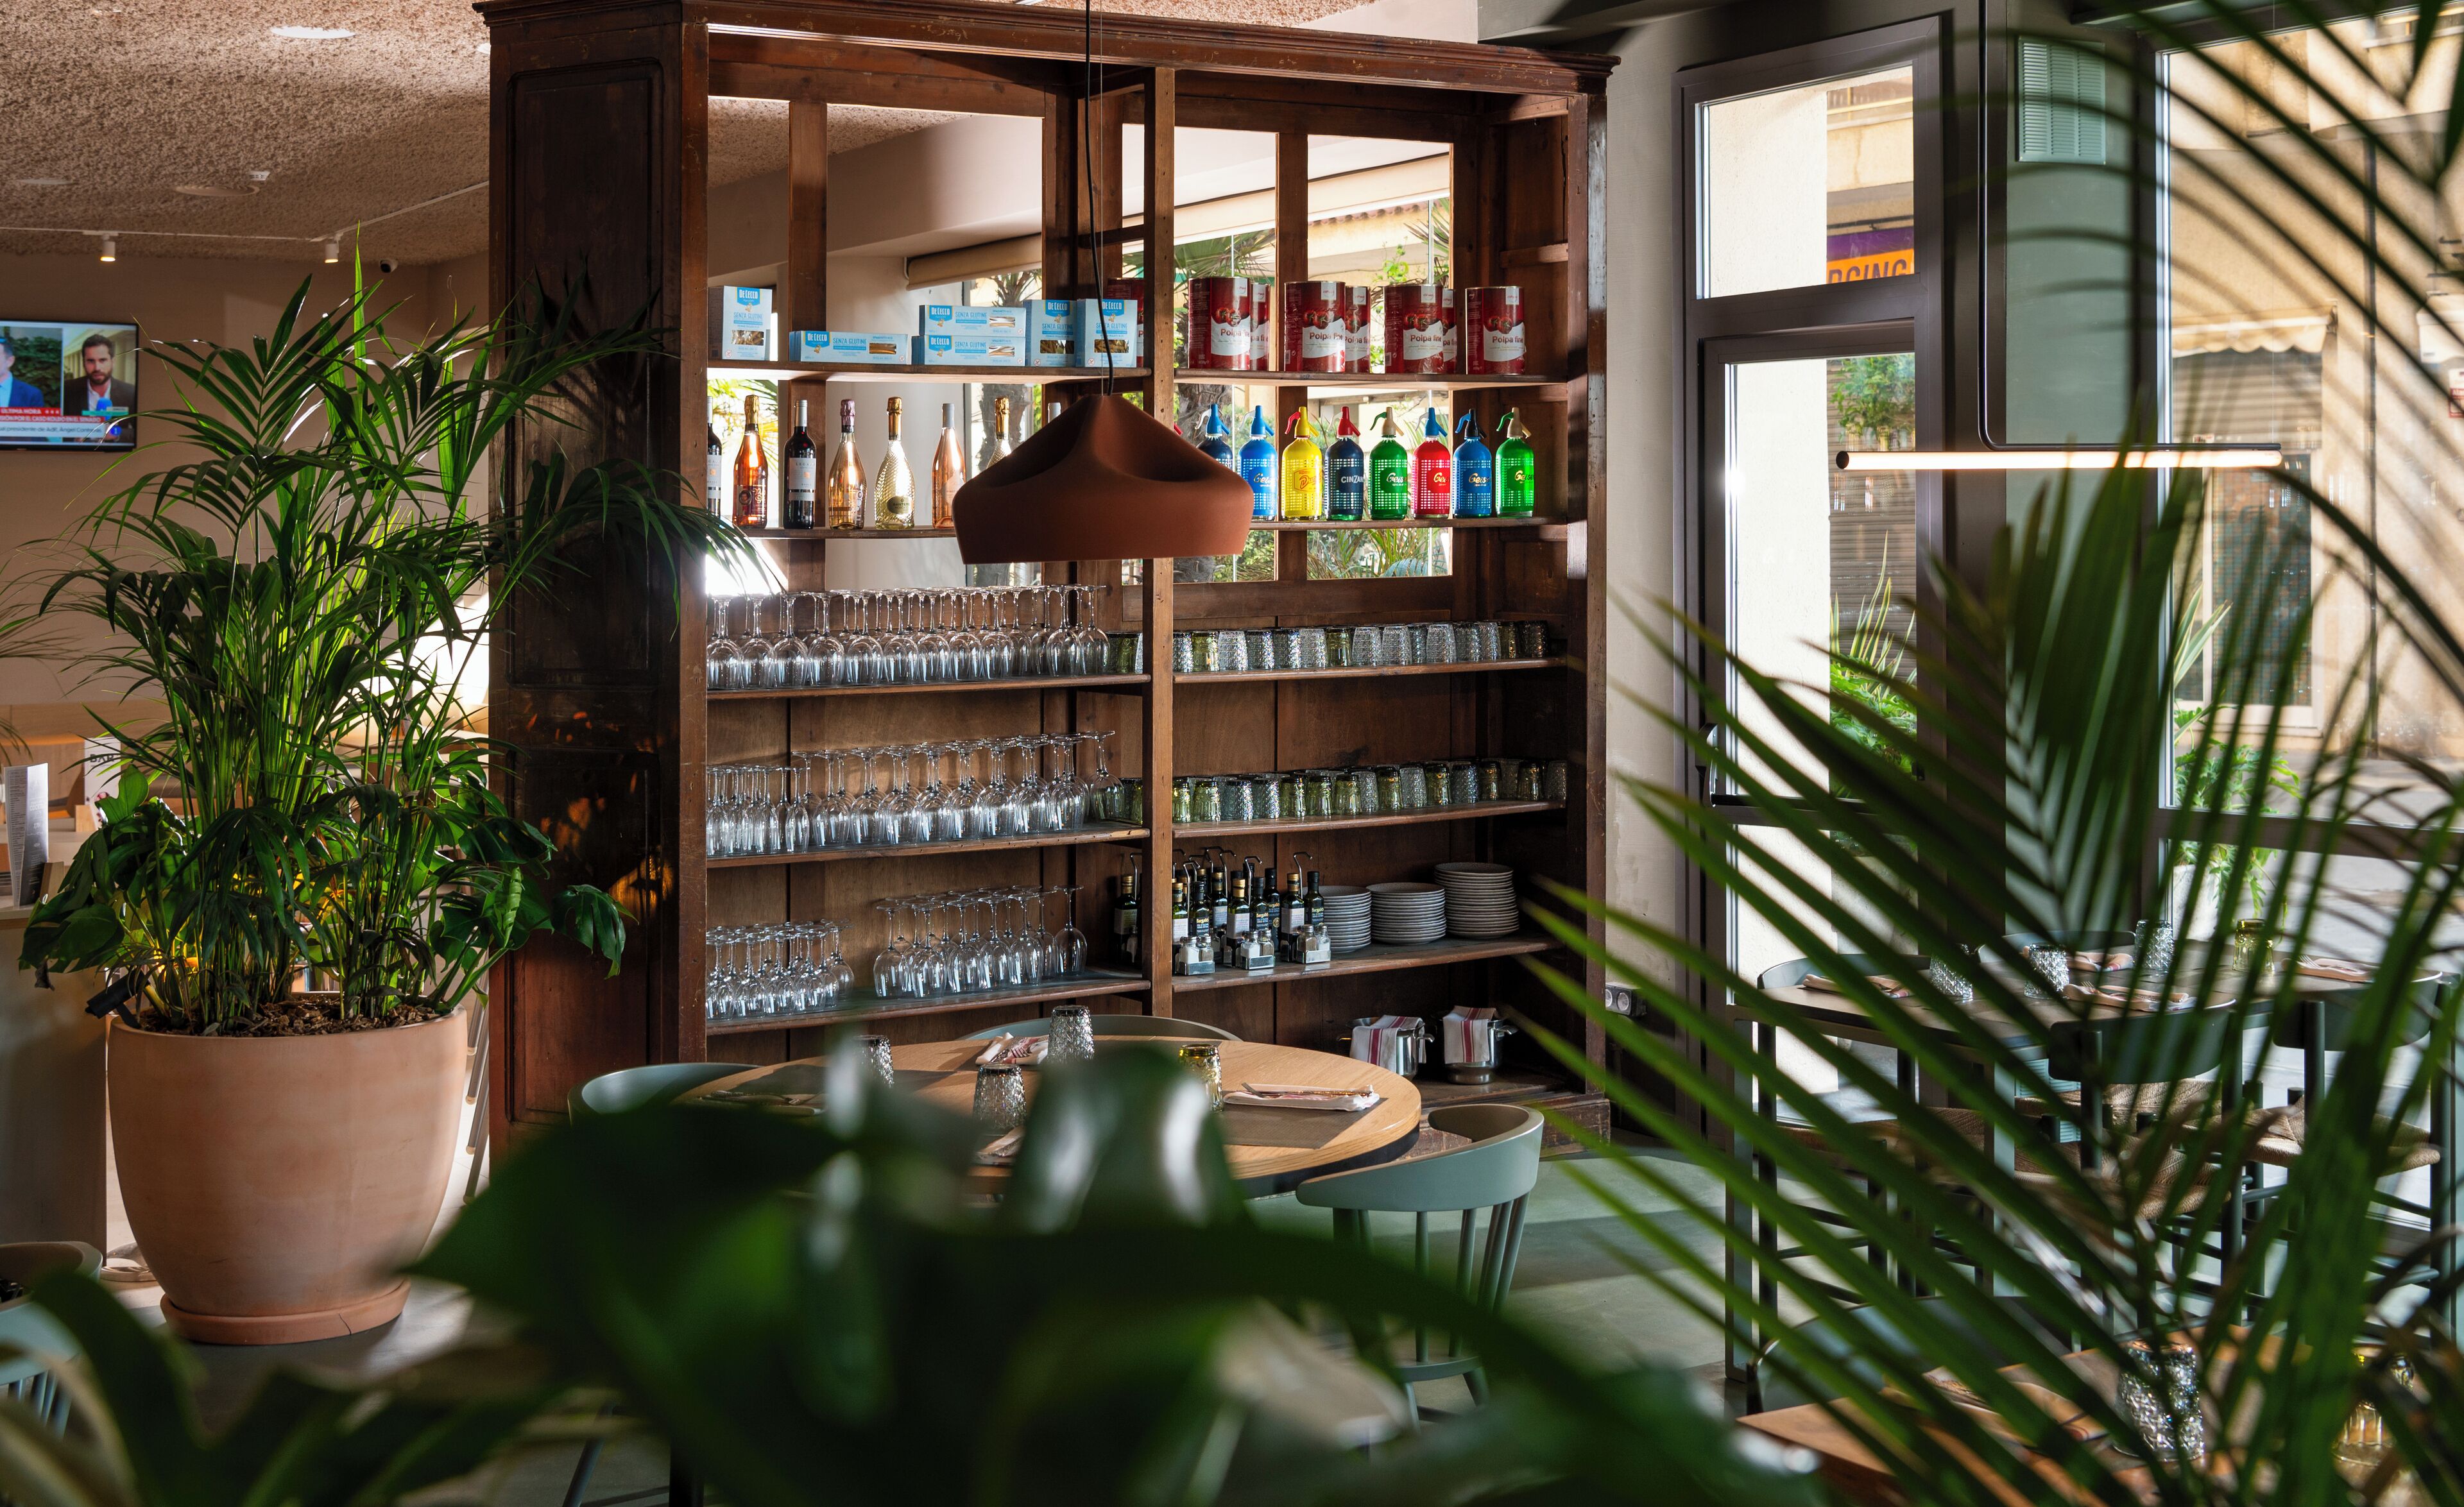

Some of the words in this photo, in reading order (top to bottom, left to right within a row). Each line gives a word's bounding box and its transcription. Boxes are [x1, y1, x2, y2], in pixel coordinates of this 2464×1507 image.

[739, 289, 745, 298] DE
[745, 290, 758, 299] CECCO
[1054, 302, 1068, 311] CECCO
[1220, 328, 1242, 337] Polpa
[1310, 332, 1331, 341] Polpa
[1493, 336, 1513, 344] Polpa
